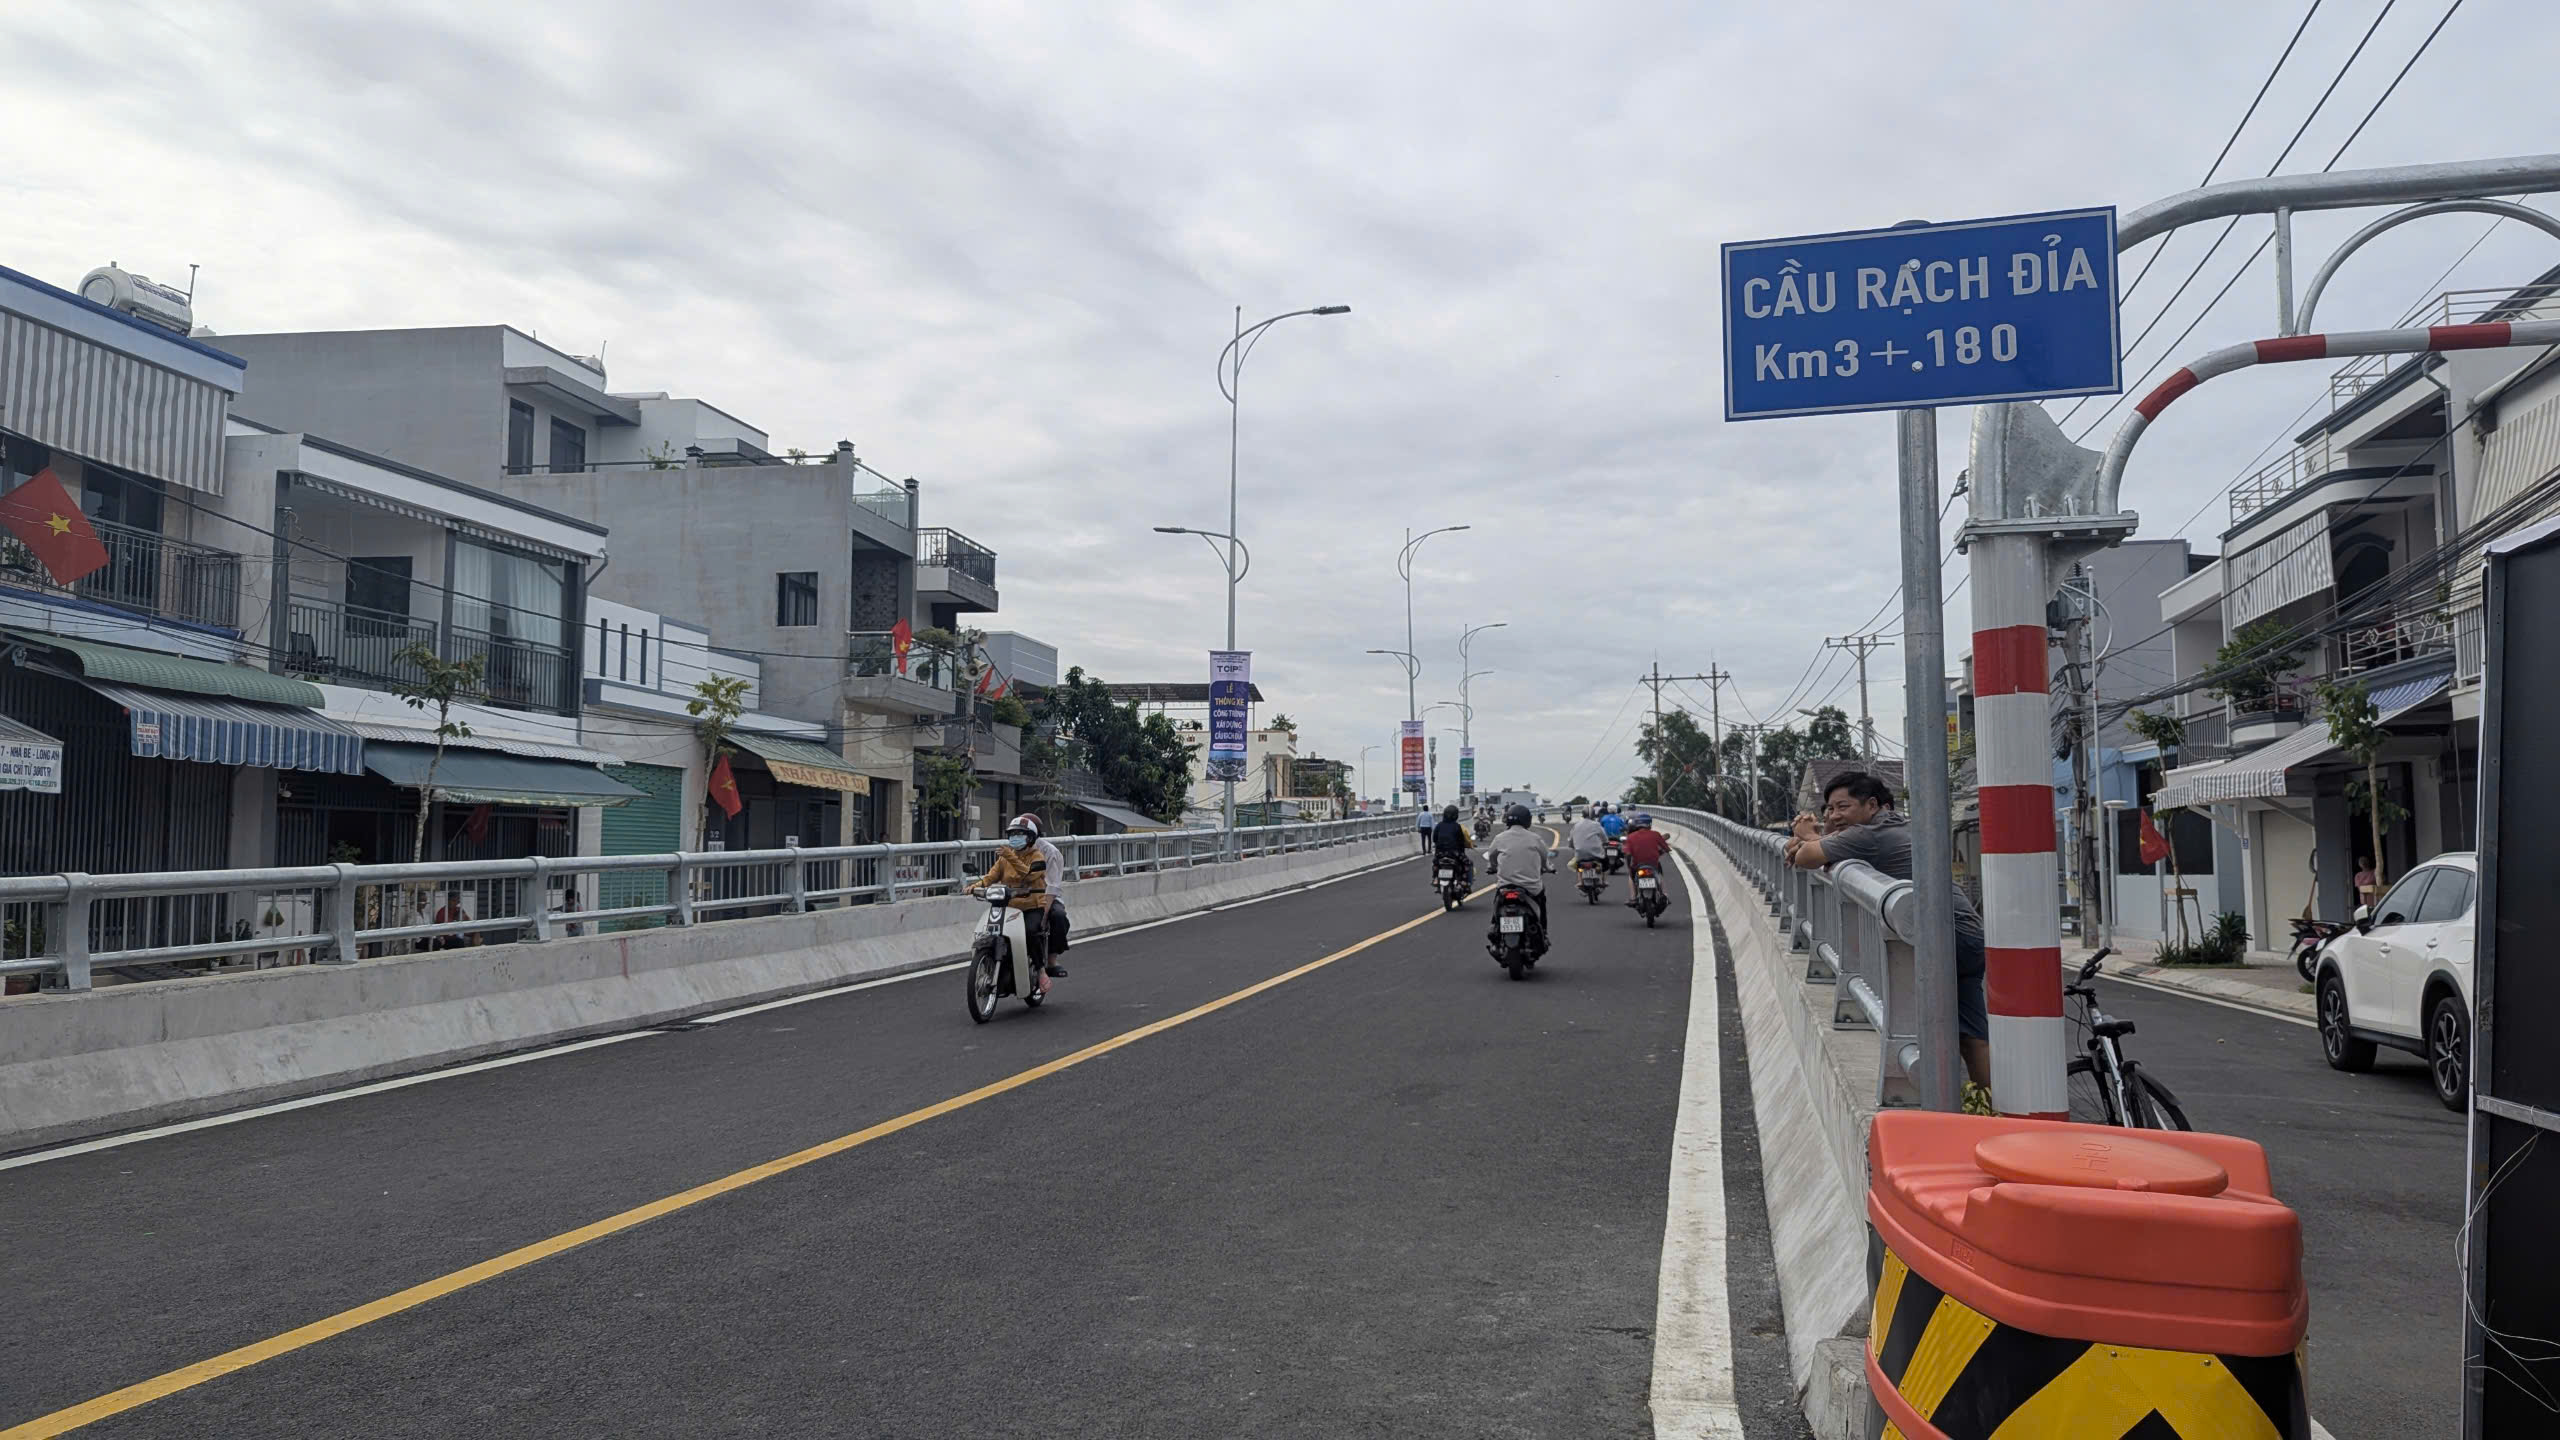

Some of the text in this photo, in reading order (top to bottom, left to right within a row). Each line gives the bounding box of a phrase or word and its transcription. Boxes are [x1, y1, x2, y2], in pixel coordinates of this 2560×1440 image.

[1744, 234, 2098, 319] CẦU RẠCH ĐỈA
[1755, 339, 1860, 382] Km3
